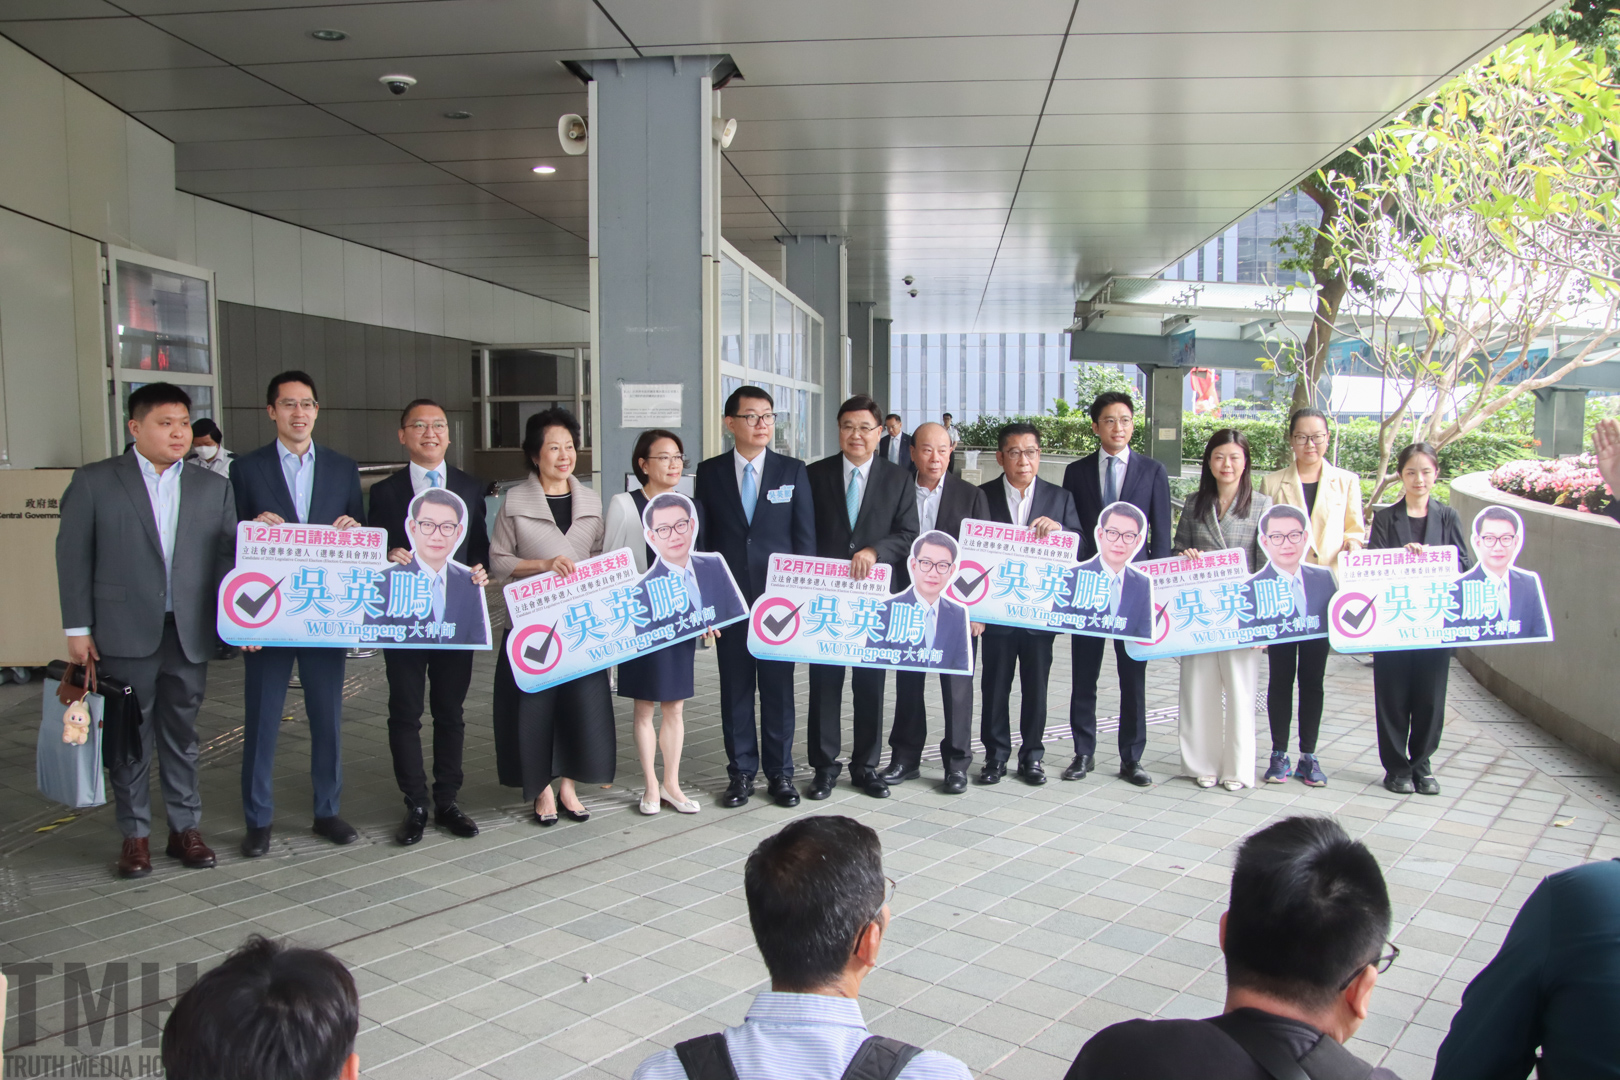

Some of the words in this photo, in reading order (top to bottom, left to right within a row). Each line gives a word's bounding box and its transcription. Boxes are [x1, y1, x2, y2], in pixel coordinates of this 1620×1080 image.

[25, 498, 58, 509] 政府總
[245, 527, 381, 547] 12月7日請投票支持
[774, 559, 886, 581] 12月7日請投持
[1140, 552, 1240, 576] 2月7日請投票支持
[1344, 550, 1452, 566] 12月7日請投票支持
[511, 554, 629, 600] 12月7日請投票支持
[993, 559, 1112, 612] 吳英鵬
[287, 566, 432, 619] 吳英鵬
[1172, 576, 1296, 630] 吳英鵬
[1380, 580, 1500, 626] 吳英鵬
[562, 571, 686, 652] 吳英鵬
[804, 595, 926, 646] 吳英鵬
[1006, 604, 1029, 618] WU
[1031, 607, 1086, 628] Yingpeng
[1088, 614, 1127, 630] 大律師
[307, 621, 335, 636] WU
[338, 621, 406, 642] Yingpeng
[409, 621, 456, 639] 大律師
[588, 644, 614, 662] WU
[615, 624, 674, 654] Yingpeng
[676, 606, 716, 632] 大律師
[1193, 632, 1217, 644] WU
[1218, 623, 1277, 644] Yingpeng
[1278, 615, 1321, 633] 大律師
[1398, 628, 1421, 640] WU
[1424, 625, 1479, 642] Yingpeng
[1481, 620, 1521, 635] 大律師
[818, 642, 842, 655] WU
[844, 644, 901, 664] Yingpeng
[903, 647, 943, 664] 大律師
